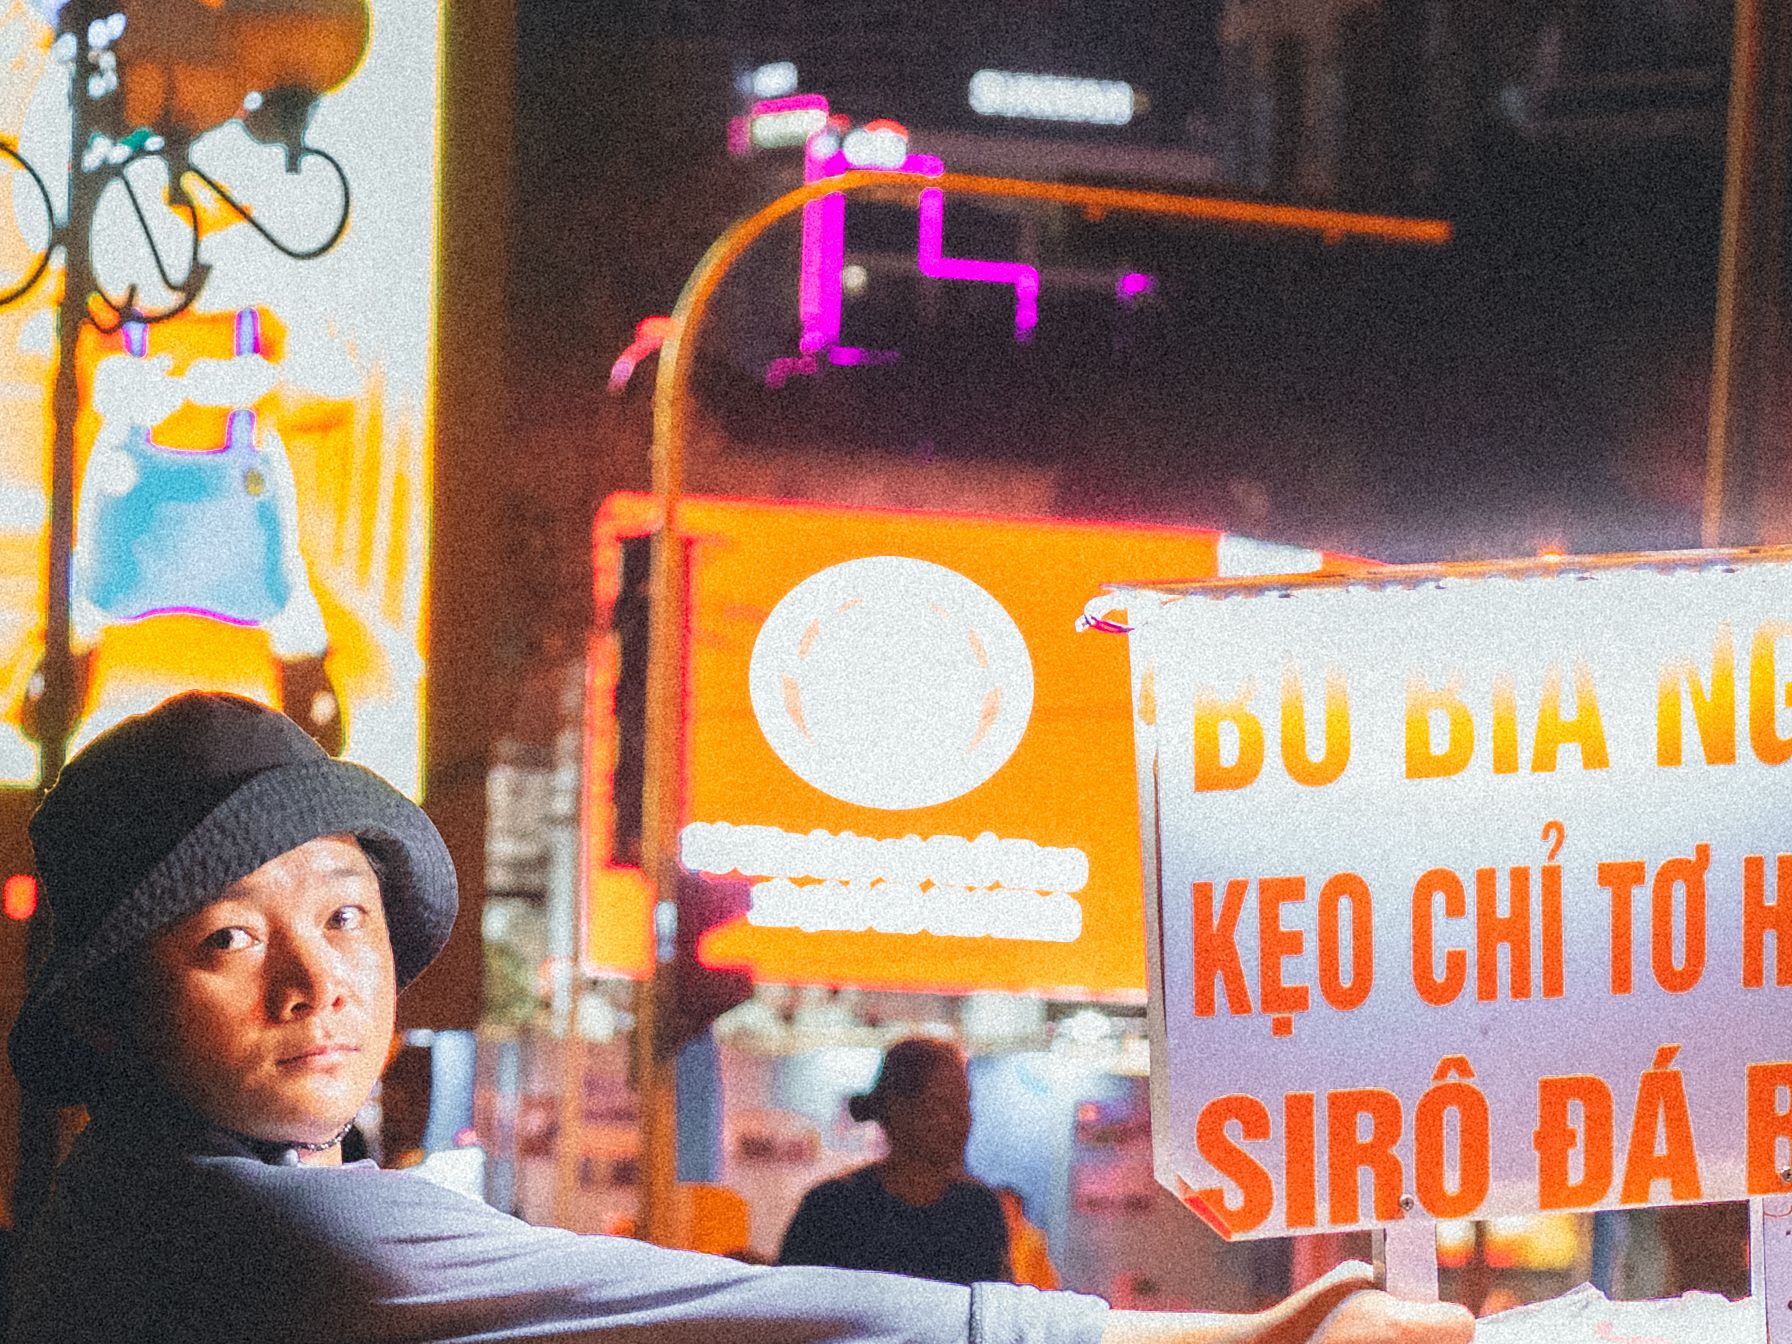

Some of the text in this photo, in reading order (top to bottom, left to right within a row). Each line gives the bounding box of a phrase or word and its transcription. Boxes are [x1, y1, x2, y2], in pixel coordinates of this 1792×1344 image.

[1192, 872, 1375, 1037] KẸO
[1411, 820, 1564, 1005] CHỈ
[1597, 842, 1711, 995] TƠ
[1194, 1055, 1492, 1240] SIRÔ
[1532, 1044, 1703, 1210] ĐÁ
